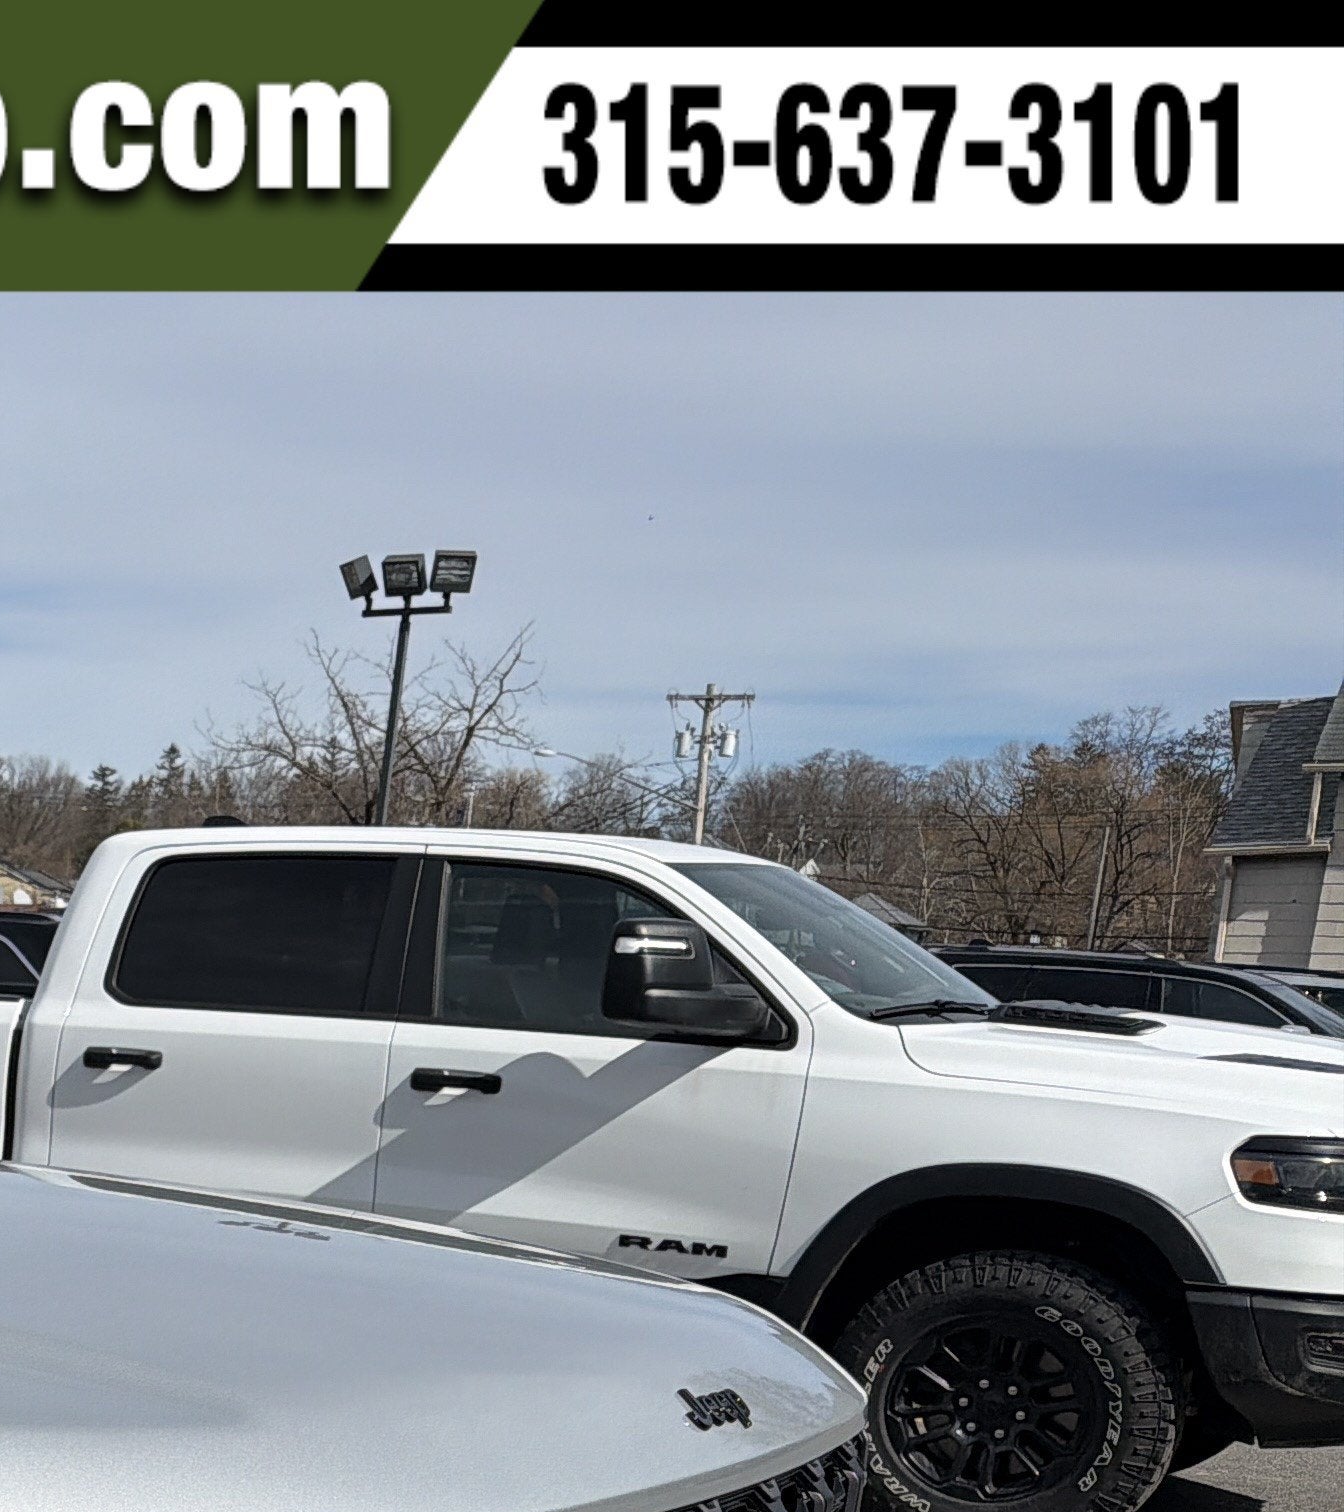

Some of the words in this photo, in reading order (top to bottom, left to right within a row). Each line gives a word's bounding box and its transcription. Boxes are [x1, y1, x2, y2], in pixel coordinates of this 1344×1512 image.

[618, 1234, 728, 1258] RAM
[676, 1388, 752, 1431] Jeep
[1035, 1306, 1123, 1491] GOODYEAR
